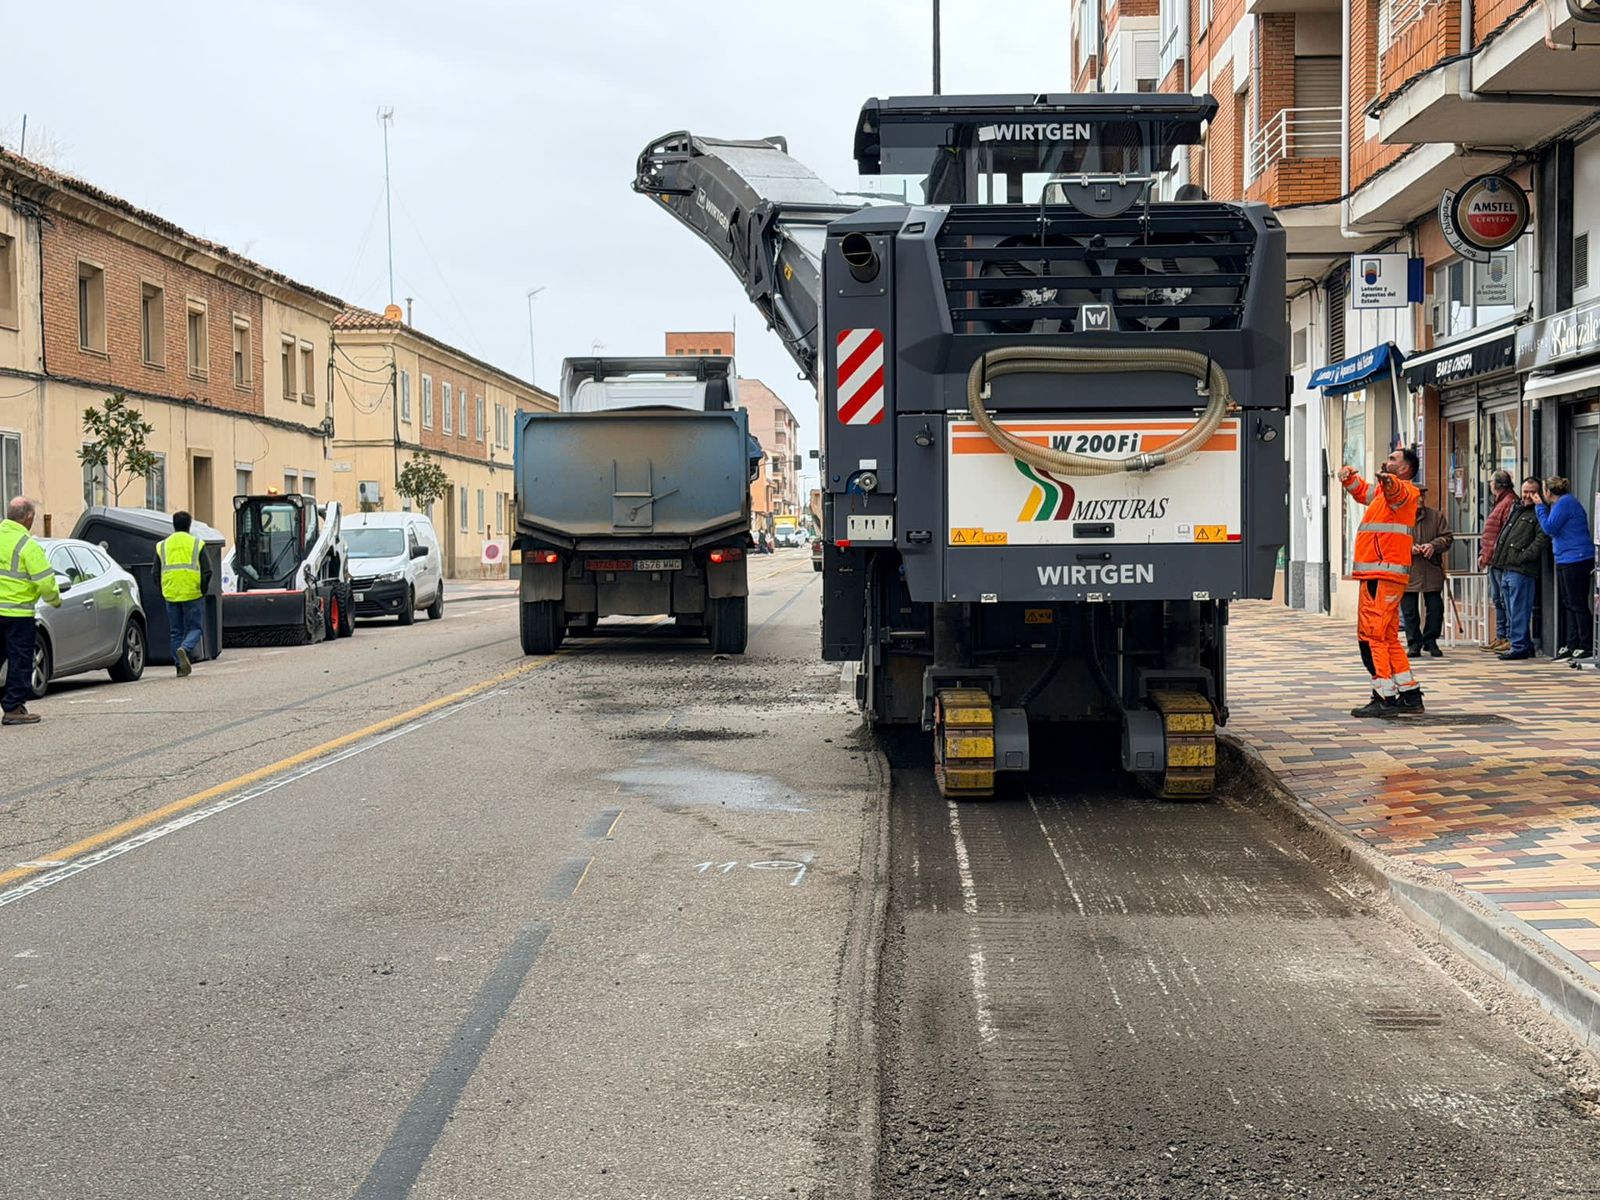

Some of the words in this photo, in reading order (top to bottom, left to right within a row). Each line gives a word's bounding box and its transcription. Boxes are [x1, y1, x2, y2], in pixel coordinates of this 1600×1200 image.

[993, 123, 1091, 141] WIRTGEN
[1473, 202, 1515, 212] AMSTEL
[1086, 311, 1106, 325] W
[1435, 360, 1448, 378] BAR
[1052, 435, 1072, 452] W
[1072, 497, 1169, 521] MISTURAS
[1036, 563, 1154, 586] WIRTGEN
